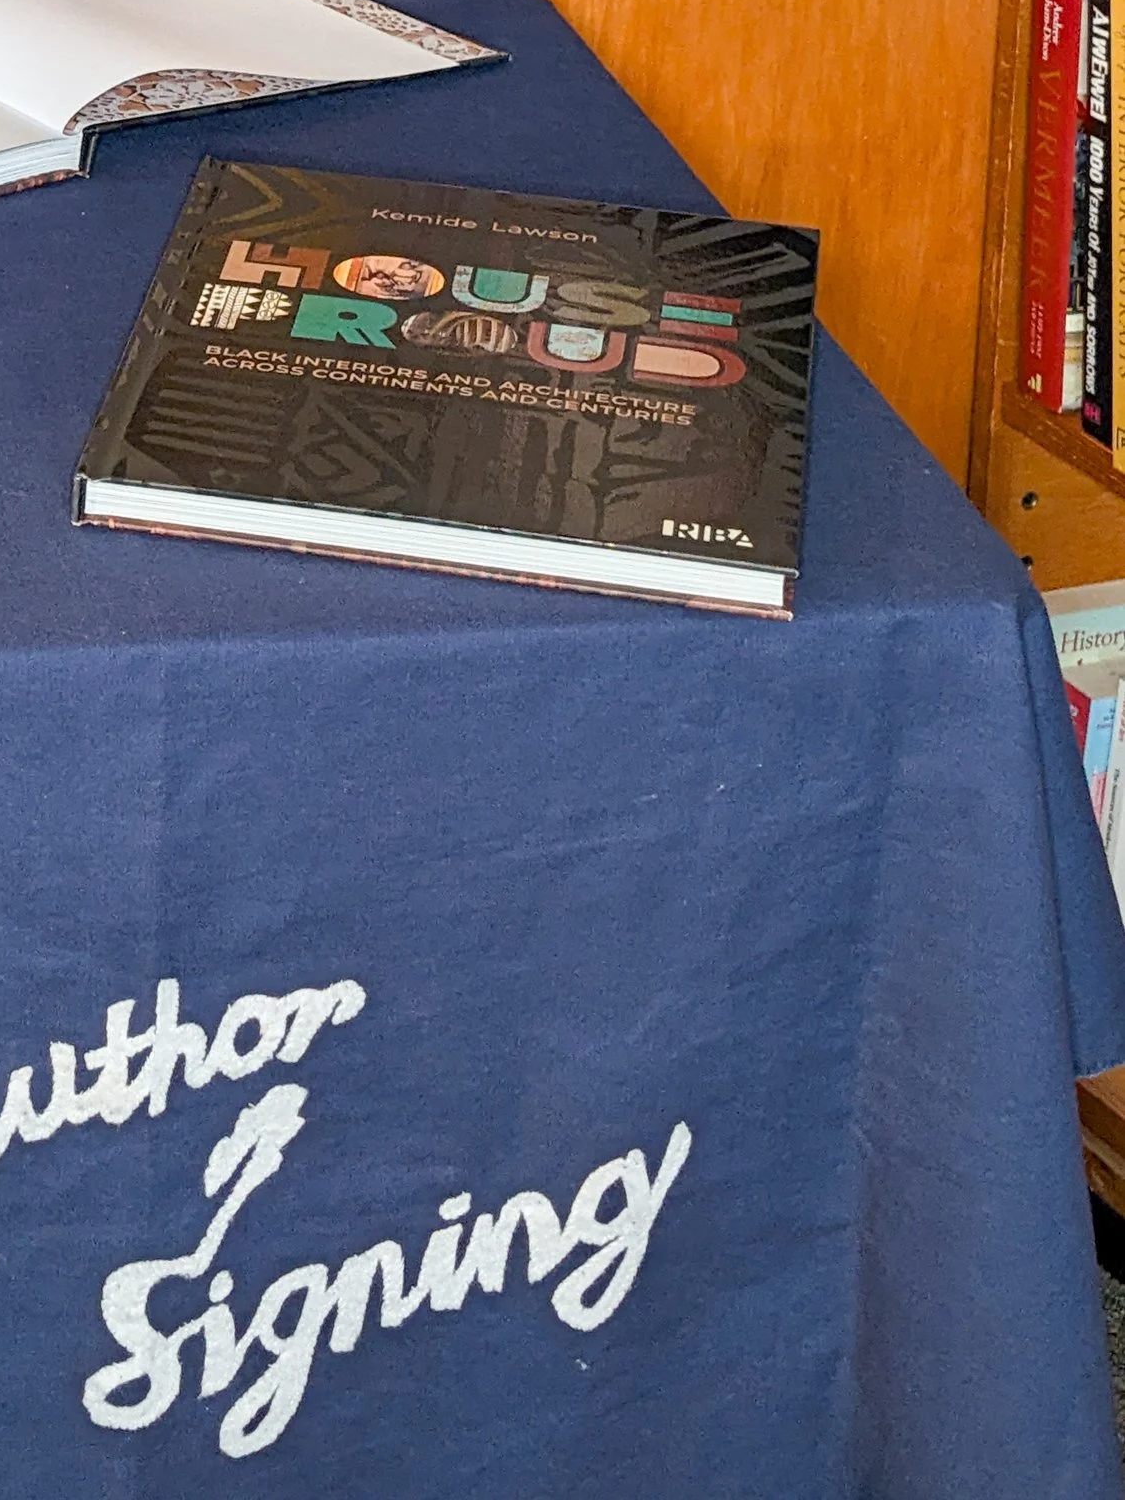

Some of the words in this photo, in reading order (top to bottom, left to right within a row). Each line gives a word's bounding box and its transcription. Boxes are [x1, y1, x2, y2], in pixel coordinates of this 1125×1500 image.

[1030, 70, 1062, 292] VERMEER
[1089, 135, 1105, 184] 1000
[371, 208, 478, 230] Kemide
[491, 222, 599, 244] Lawson
[219, 240, 743, 342] HOUSE
[189, 283, 747, 388] PROUD
[1084, 323, 1097, 395] SORROWS
[203, 356, 305, 377] ACROSS
[311, 367, 474, 398] CONTINENTS
[480, 390, 538, 406] AND
[545, 397, 693, 427] CENTURIES
[205, 345, 288, 364] BLACK
[294, 354, 429, 380] INTERIORS
[434, 371, 492, 387] AND
[498, 380, 697, 416] ARCHITECTURE
[82, 1084, 693, 1459] Signing
